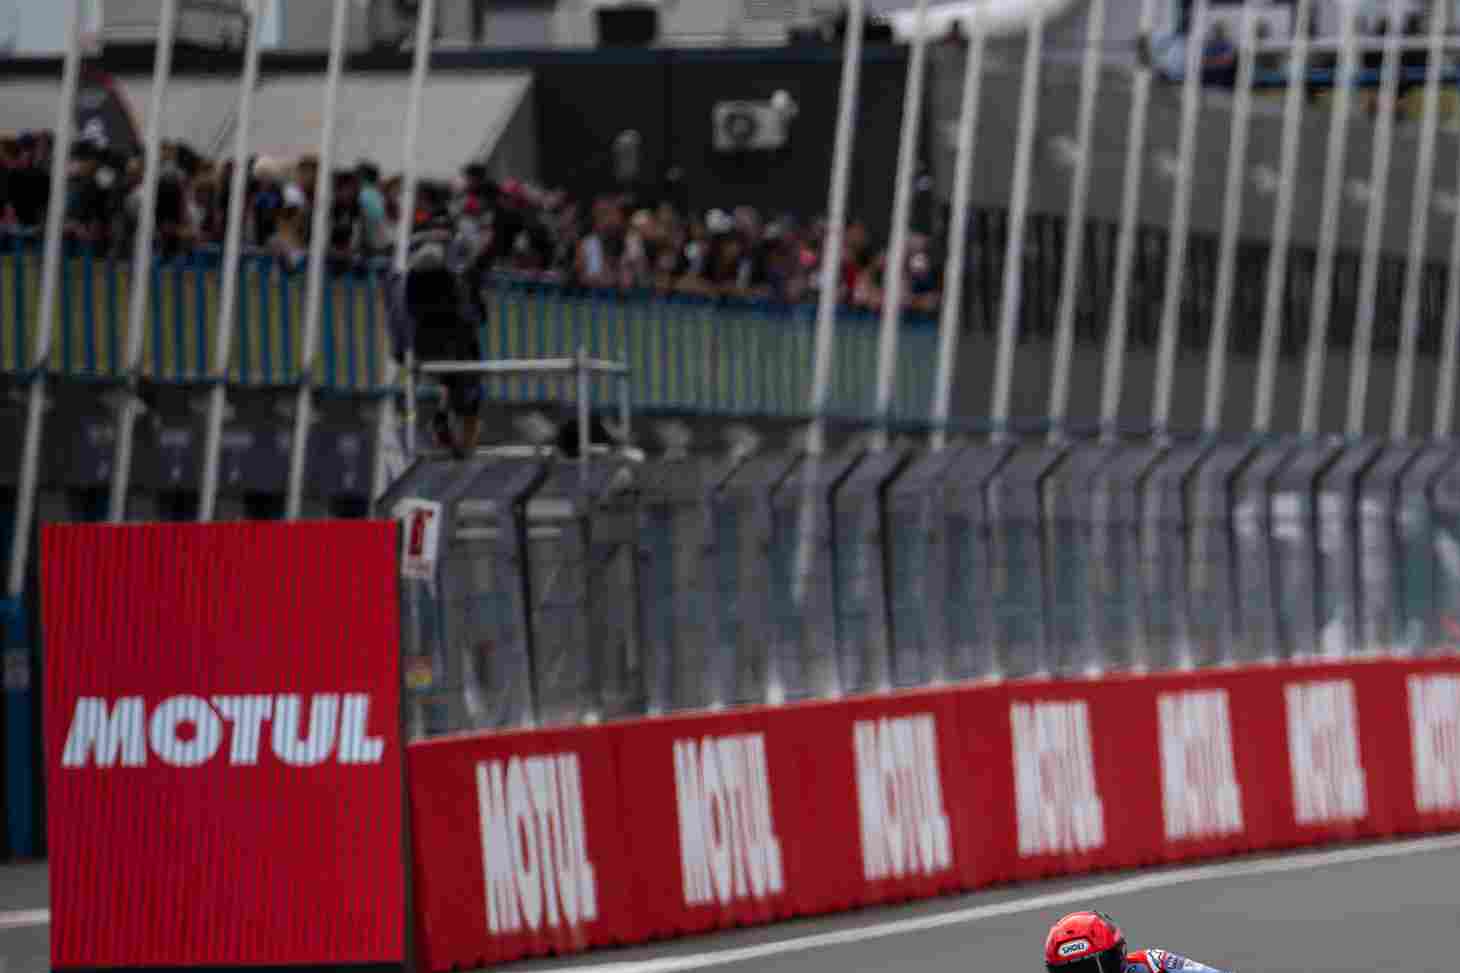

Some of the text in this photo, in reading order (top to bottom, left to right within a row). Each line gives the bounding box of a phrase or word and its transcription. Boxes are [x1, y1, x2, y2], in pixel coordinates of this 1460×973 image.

[62, 694, 385, 767] MOTUL
[476, 753, 598, 936] MOTUL
[674, 732, 784, 906] MOTUL
